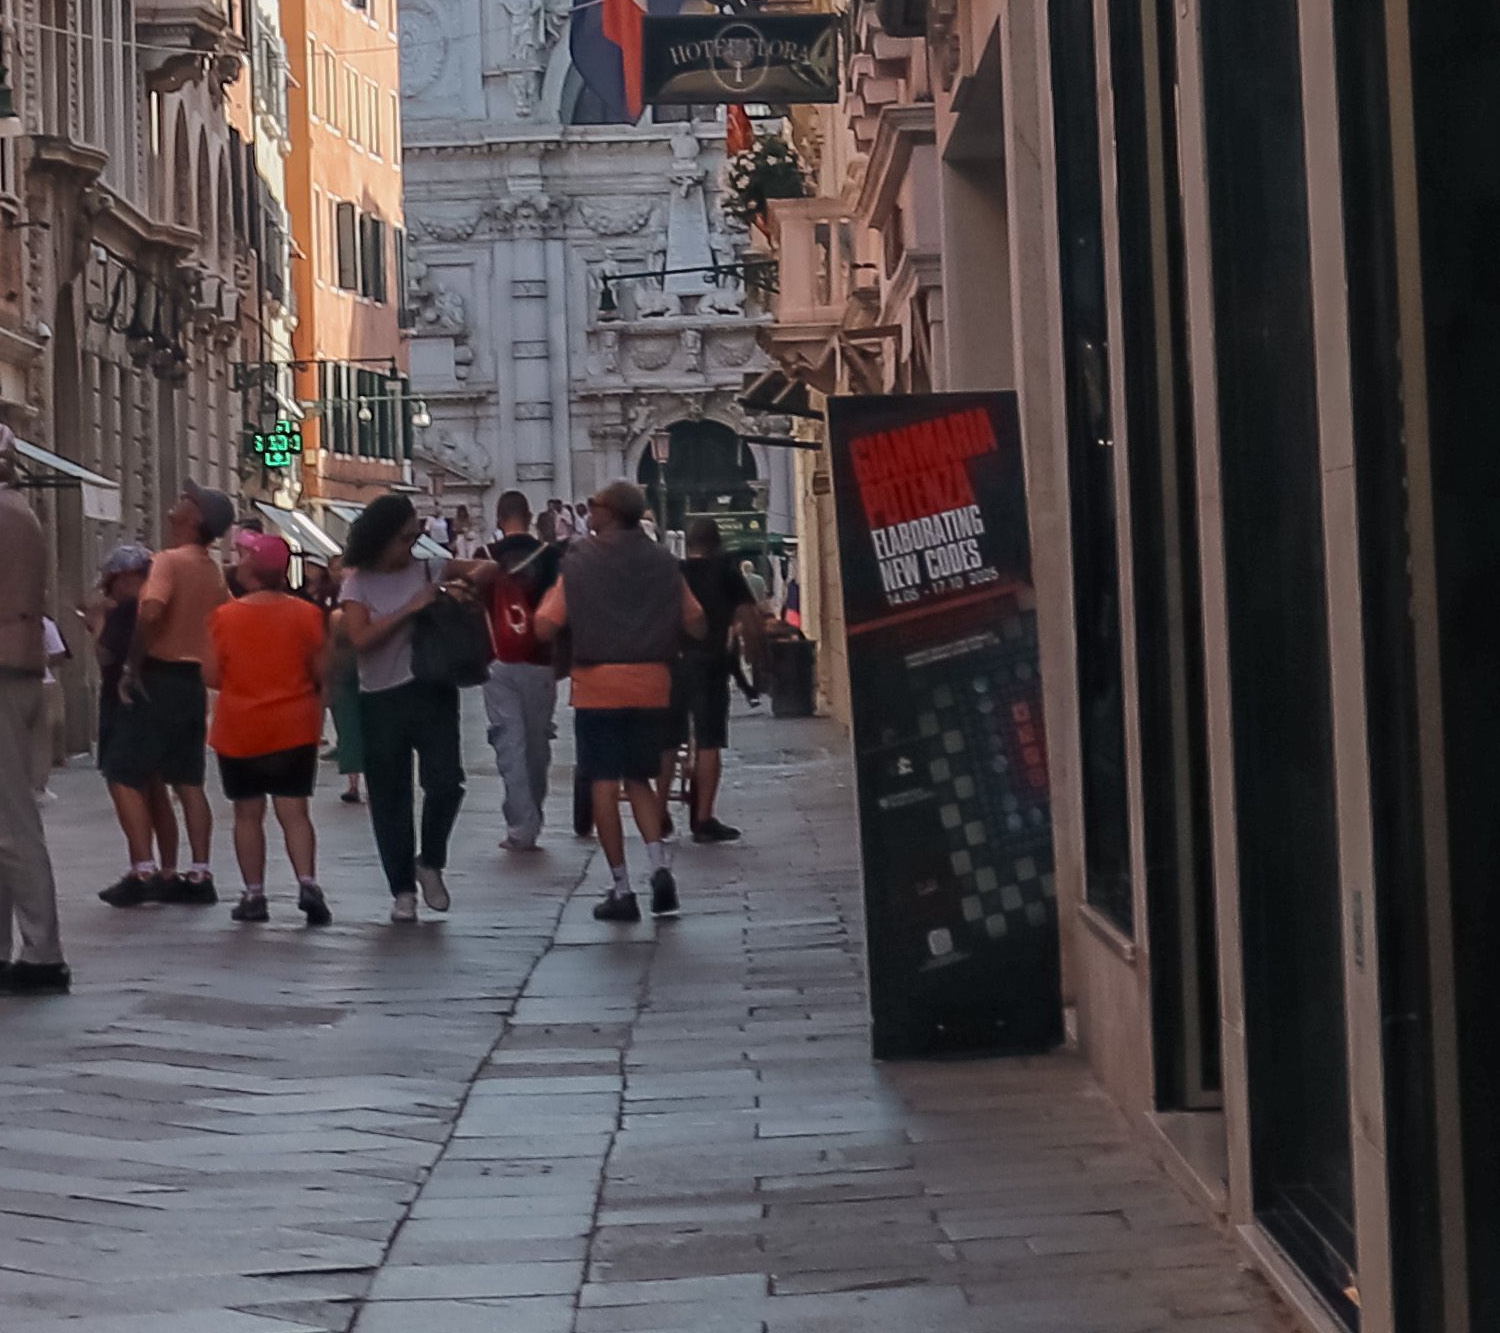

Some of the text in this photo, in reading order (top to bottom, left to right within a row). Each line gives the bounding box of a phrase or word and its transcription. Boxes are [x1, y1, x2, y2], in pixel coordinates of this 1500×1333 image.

[849, 407, 998, 483] GIANMARIA
[859, 461, 976, 527] POTENZA
[870, 505, 985, 560] ELABORATING
[879, 540, 982, 592] NEW CODES
